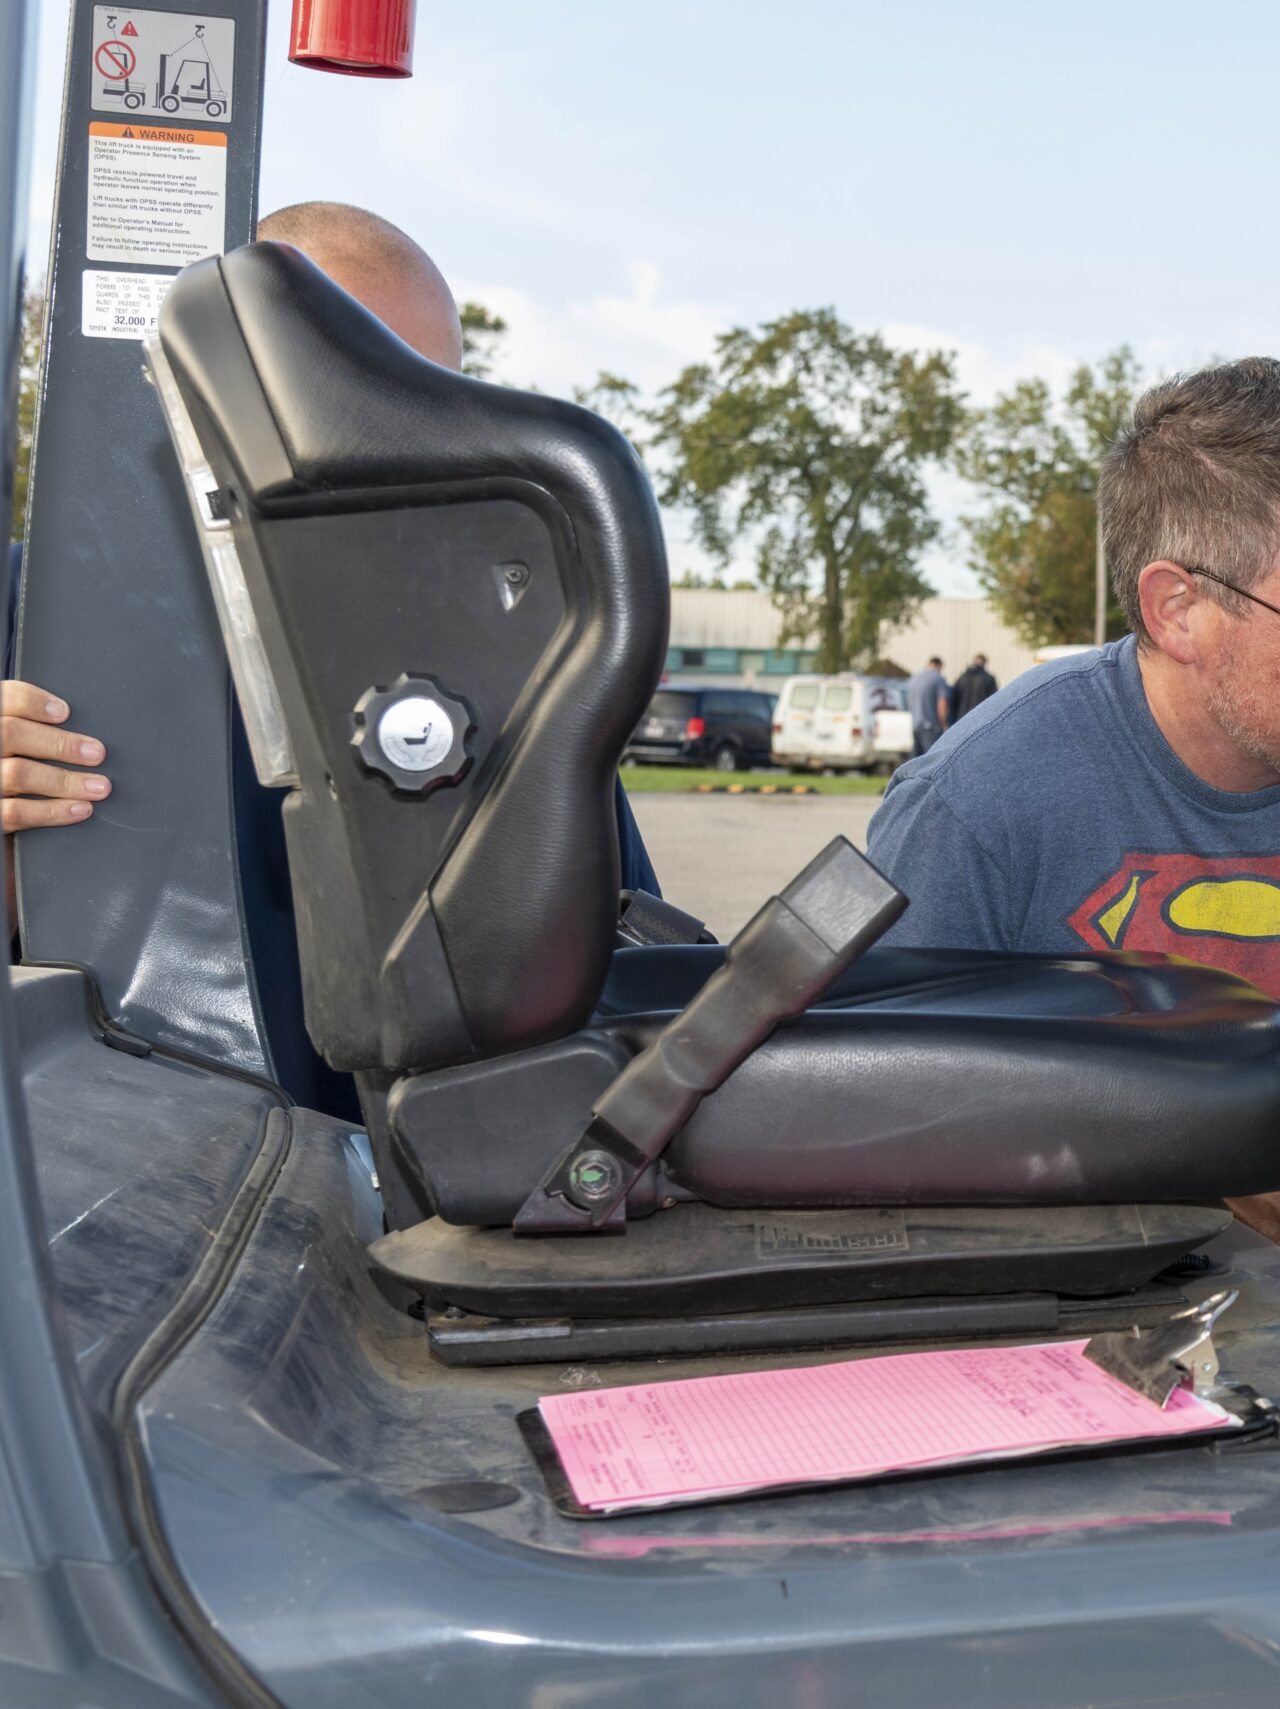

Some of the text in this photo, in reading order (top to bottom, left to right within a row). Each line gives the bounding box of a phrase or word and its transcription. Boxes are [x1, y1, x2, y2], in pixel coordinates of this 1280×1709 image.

[140, 130, 195, 142] WARNING
[152, 152, 177, 160] Sensing
[164, 188, 193, 196] operating
[182, 202, 212, 210] differently
[116, 276, 146, 284] OVERHEAD
[114, 315, 146, 326] 32,000
